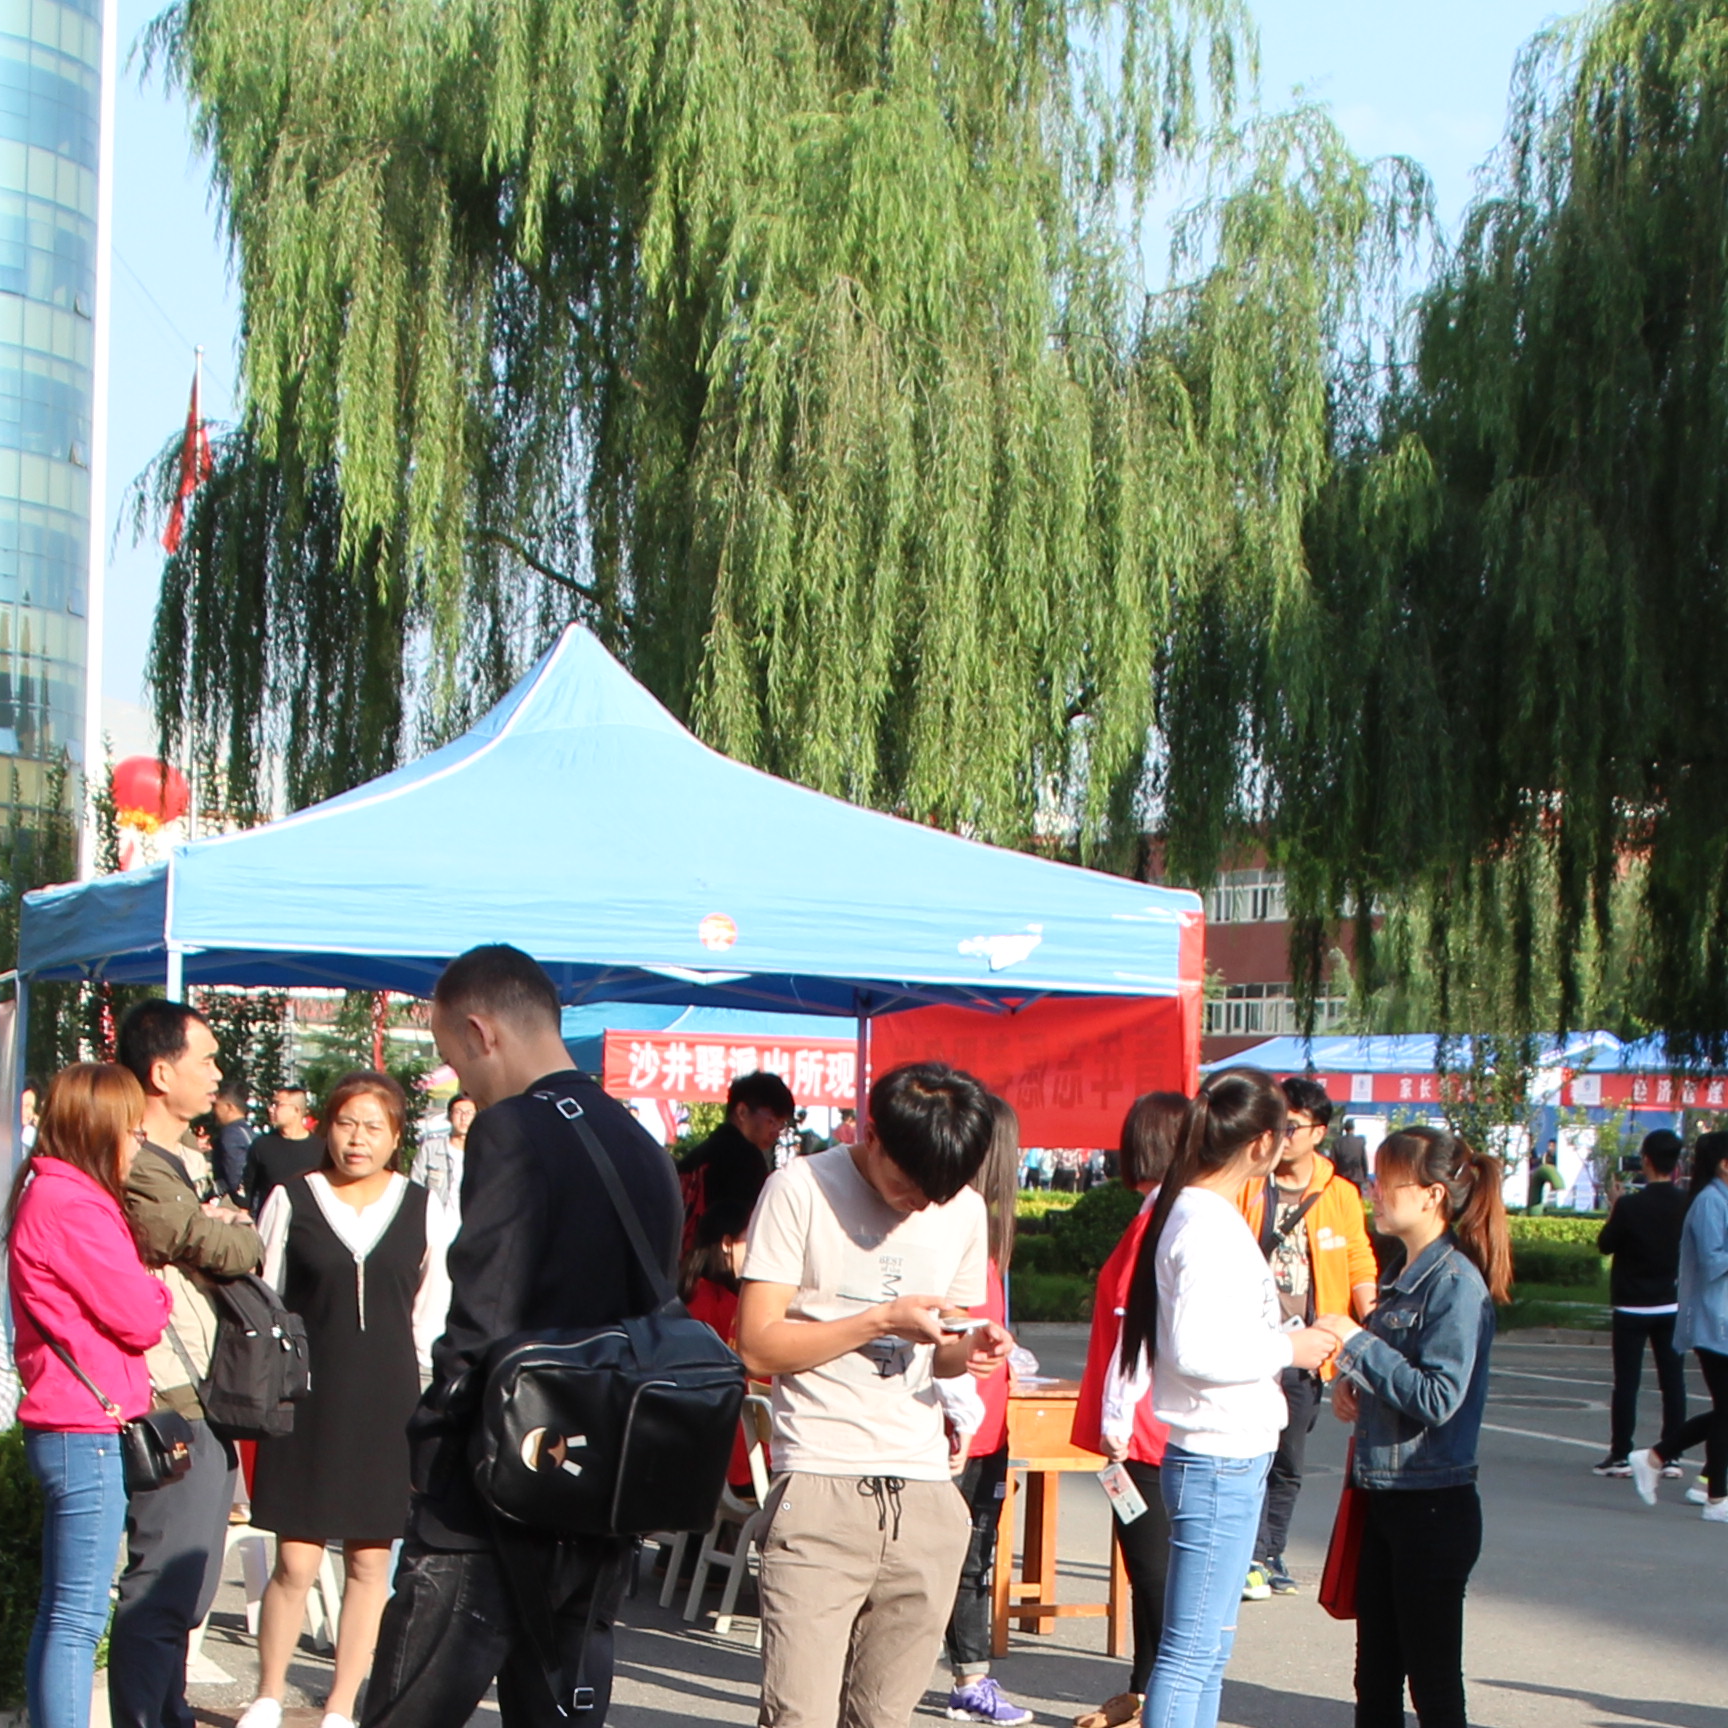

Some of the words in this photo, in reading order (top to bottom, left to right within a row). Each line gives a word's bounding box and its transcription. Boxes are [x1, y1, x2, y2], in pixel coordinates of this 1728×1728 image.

[628, 1040, 871, 1099] 沙井驿派出所现
